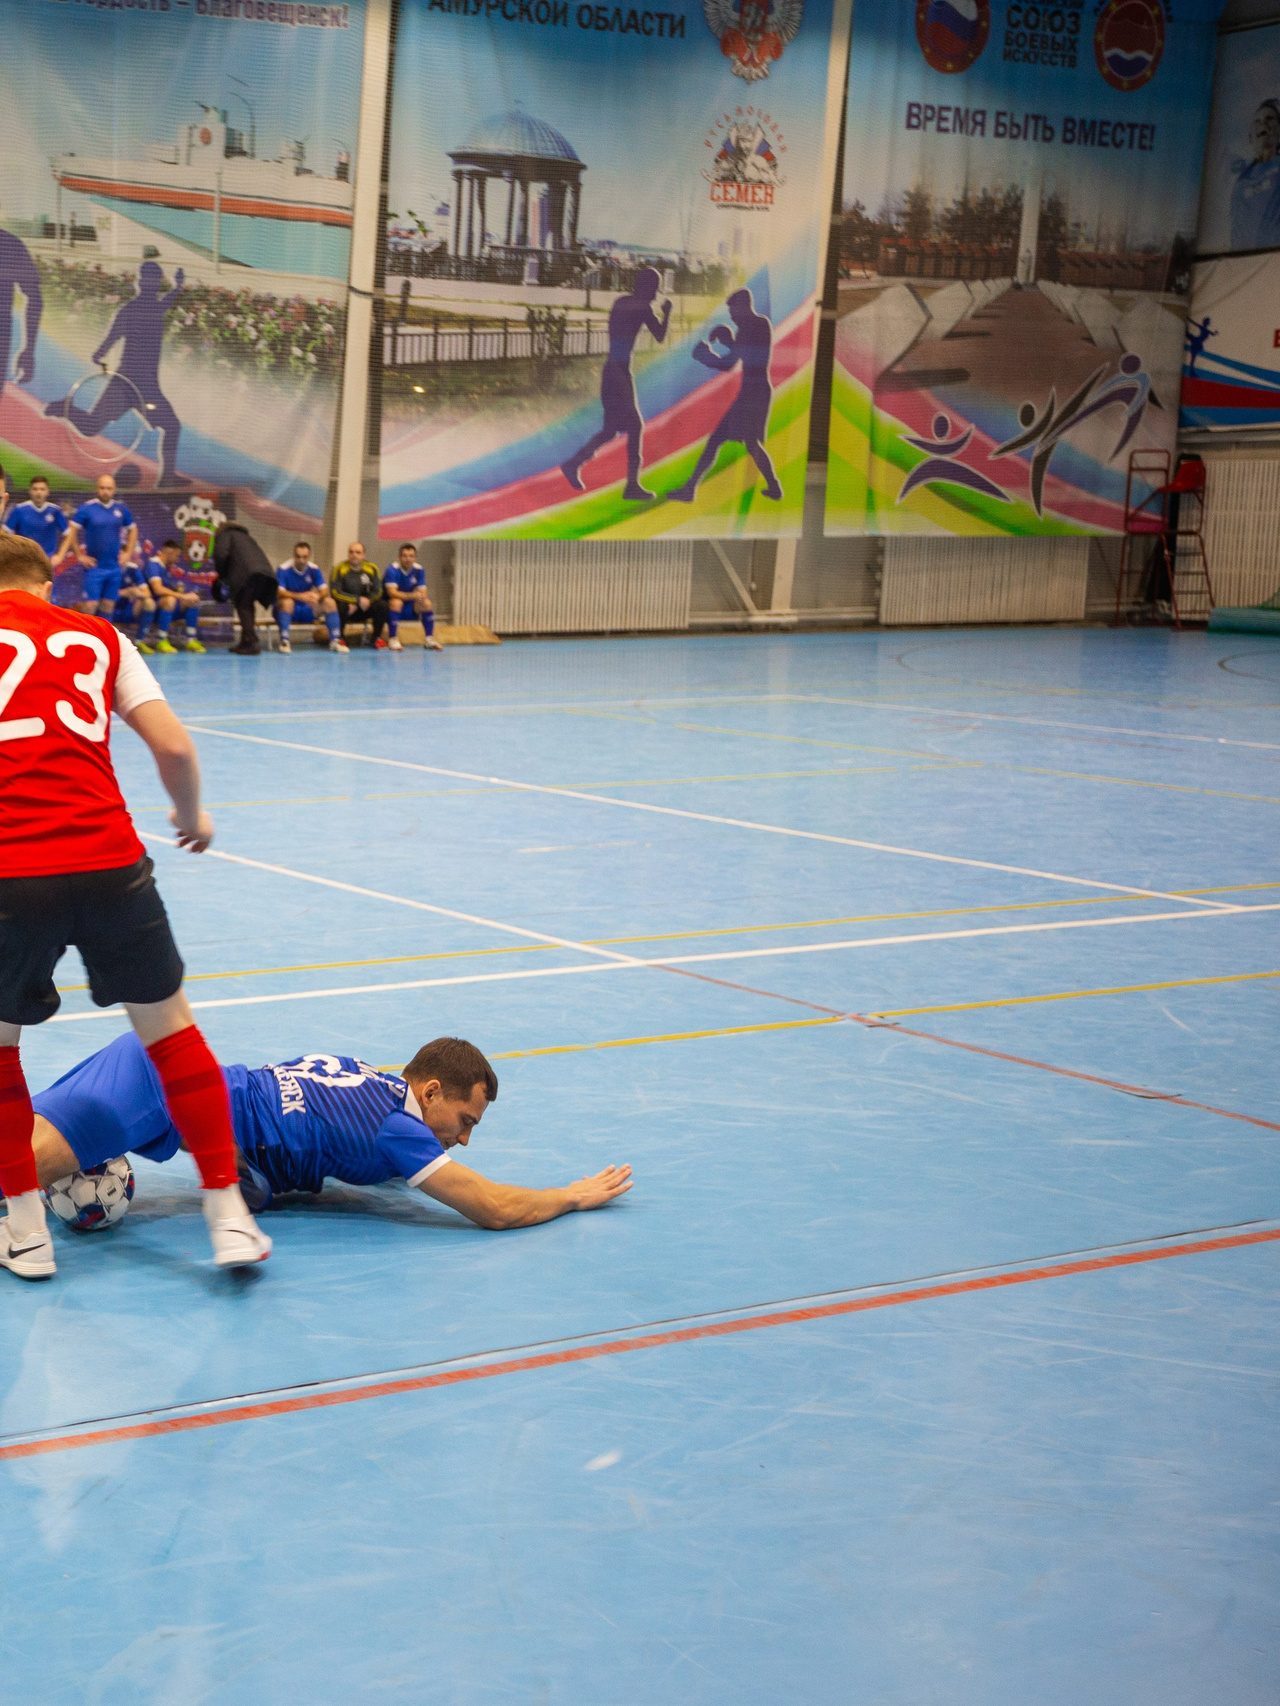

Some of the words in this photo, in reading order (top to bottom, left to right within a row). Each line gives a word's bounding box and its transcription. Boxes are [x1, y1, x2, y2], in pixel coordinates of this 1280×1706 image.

[576, 5, 686, 38] ОБЛАСТИ
[1006, 5, 1081, 35] СОЮЗ
[1004, 30, 1078, 54] БОЕВЫХ
[905, 102, 987, 137] ВРЕМЯ
[993, 110, 1055, 144] БЫТЬ
[1061, 117, 1156, 151] ВМЕСТЕ!
[709, 181, 775, 205] СЕМЕН
